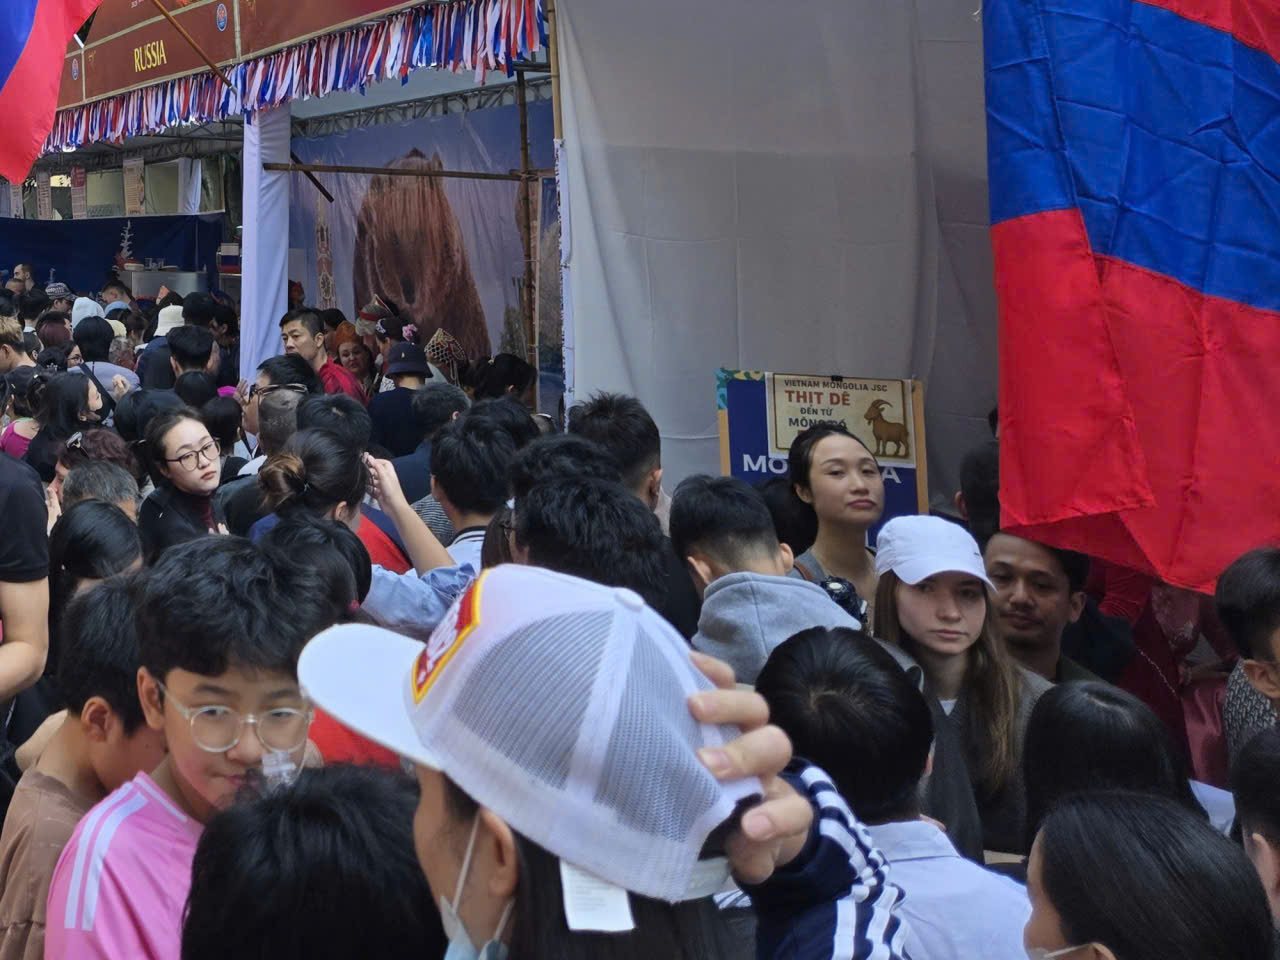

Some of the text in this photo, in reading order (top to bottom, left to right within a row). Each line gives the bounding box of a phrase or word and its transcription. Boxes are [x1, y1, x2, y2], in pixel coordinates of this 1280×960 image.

[133, 39, 168, 73] RUSSIA
[784, 380, 888, 392] VIETNAM MONGOLIA JSC
